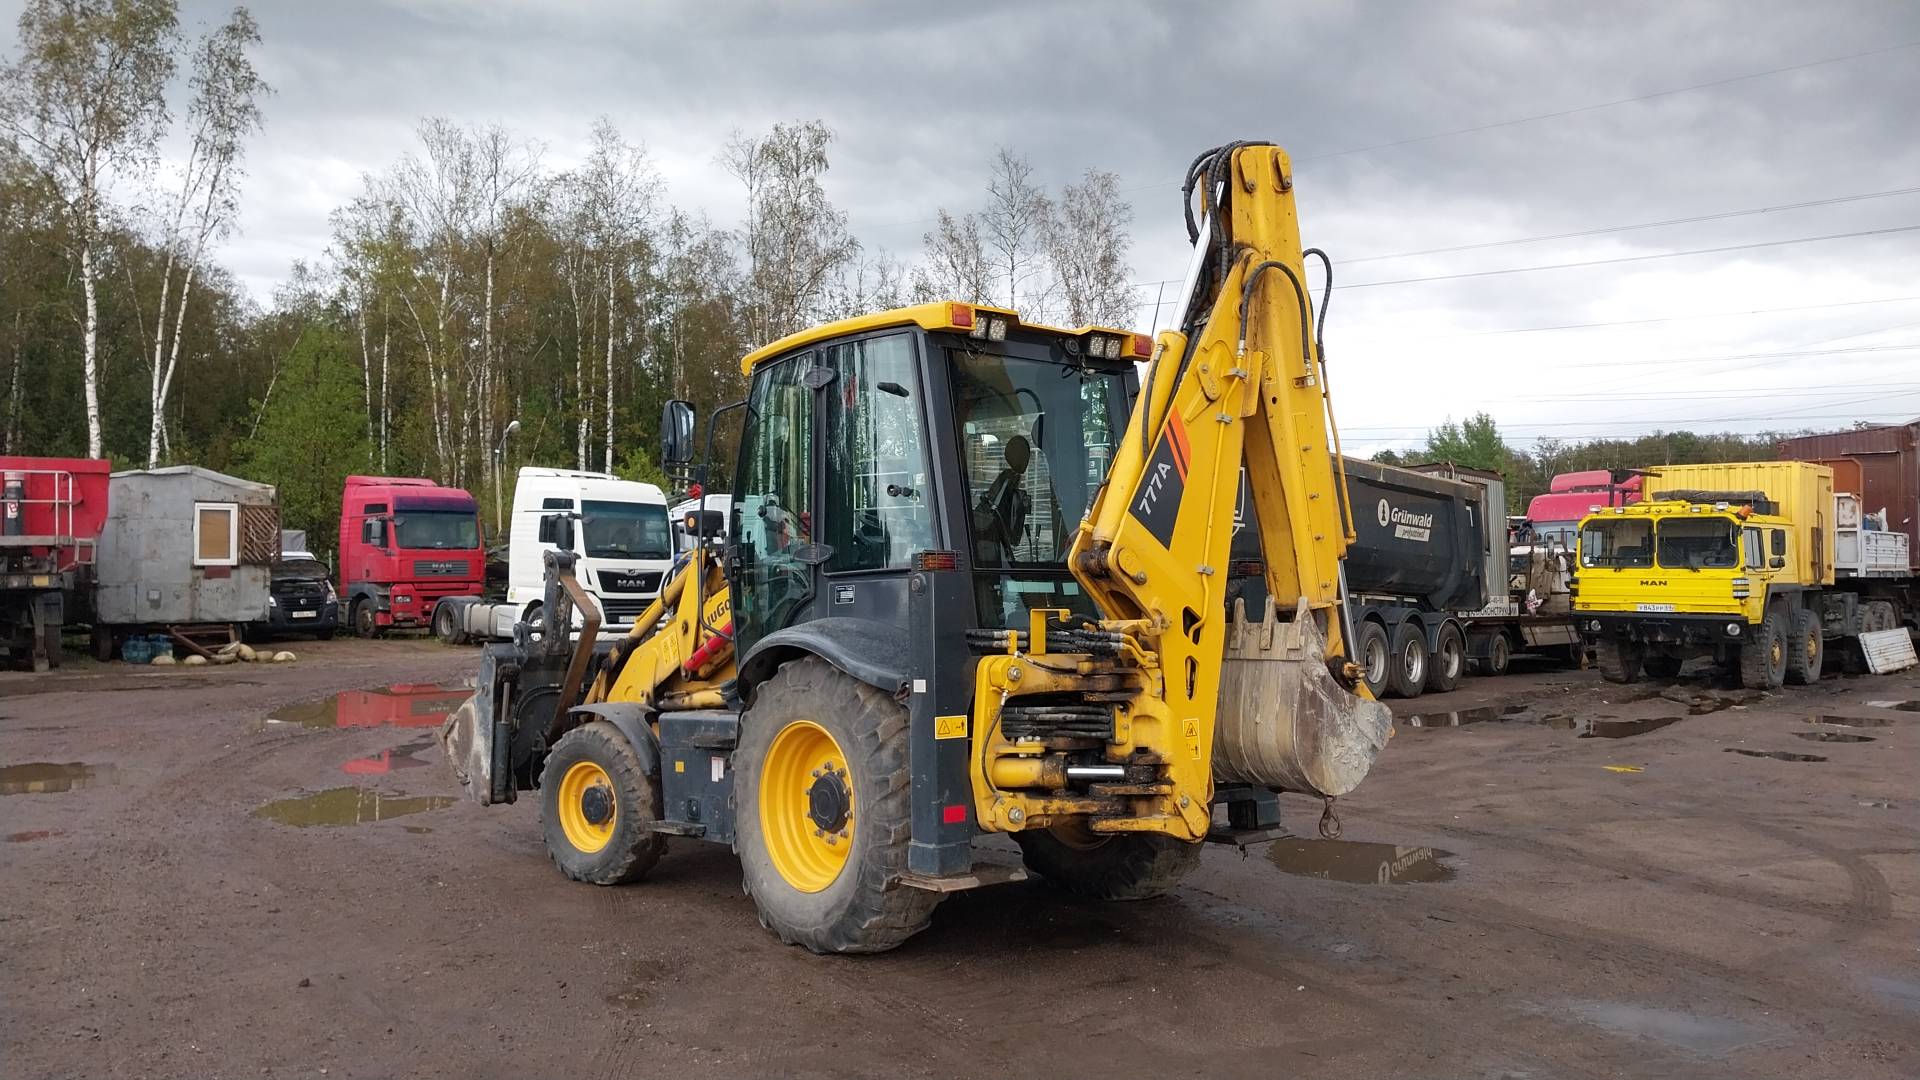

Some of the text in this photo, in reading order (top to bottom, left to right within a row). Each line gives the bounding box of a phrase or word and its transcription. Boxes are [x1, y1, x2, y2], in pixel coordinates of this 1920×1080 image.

[1139, 463, 1171, 515] 777A
[1391, 507, 1433, 528] Grünwald
[617, 579, 646, 587] MAN
